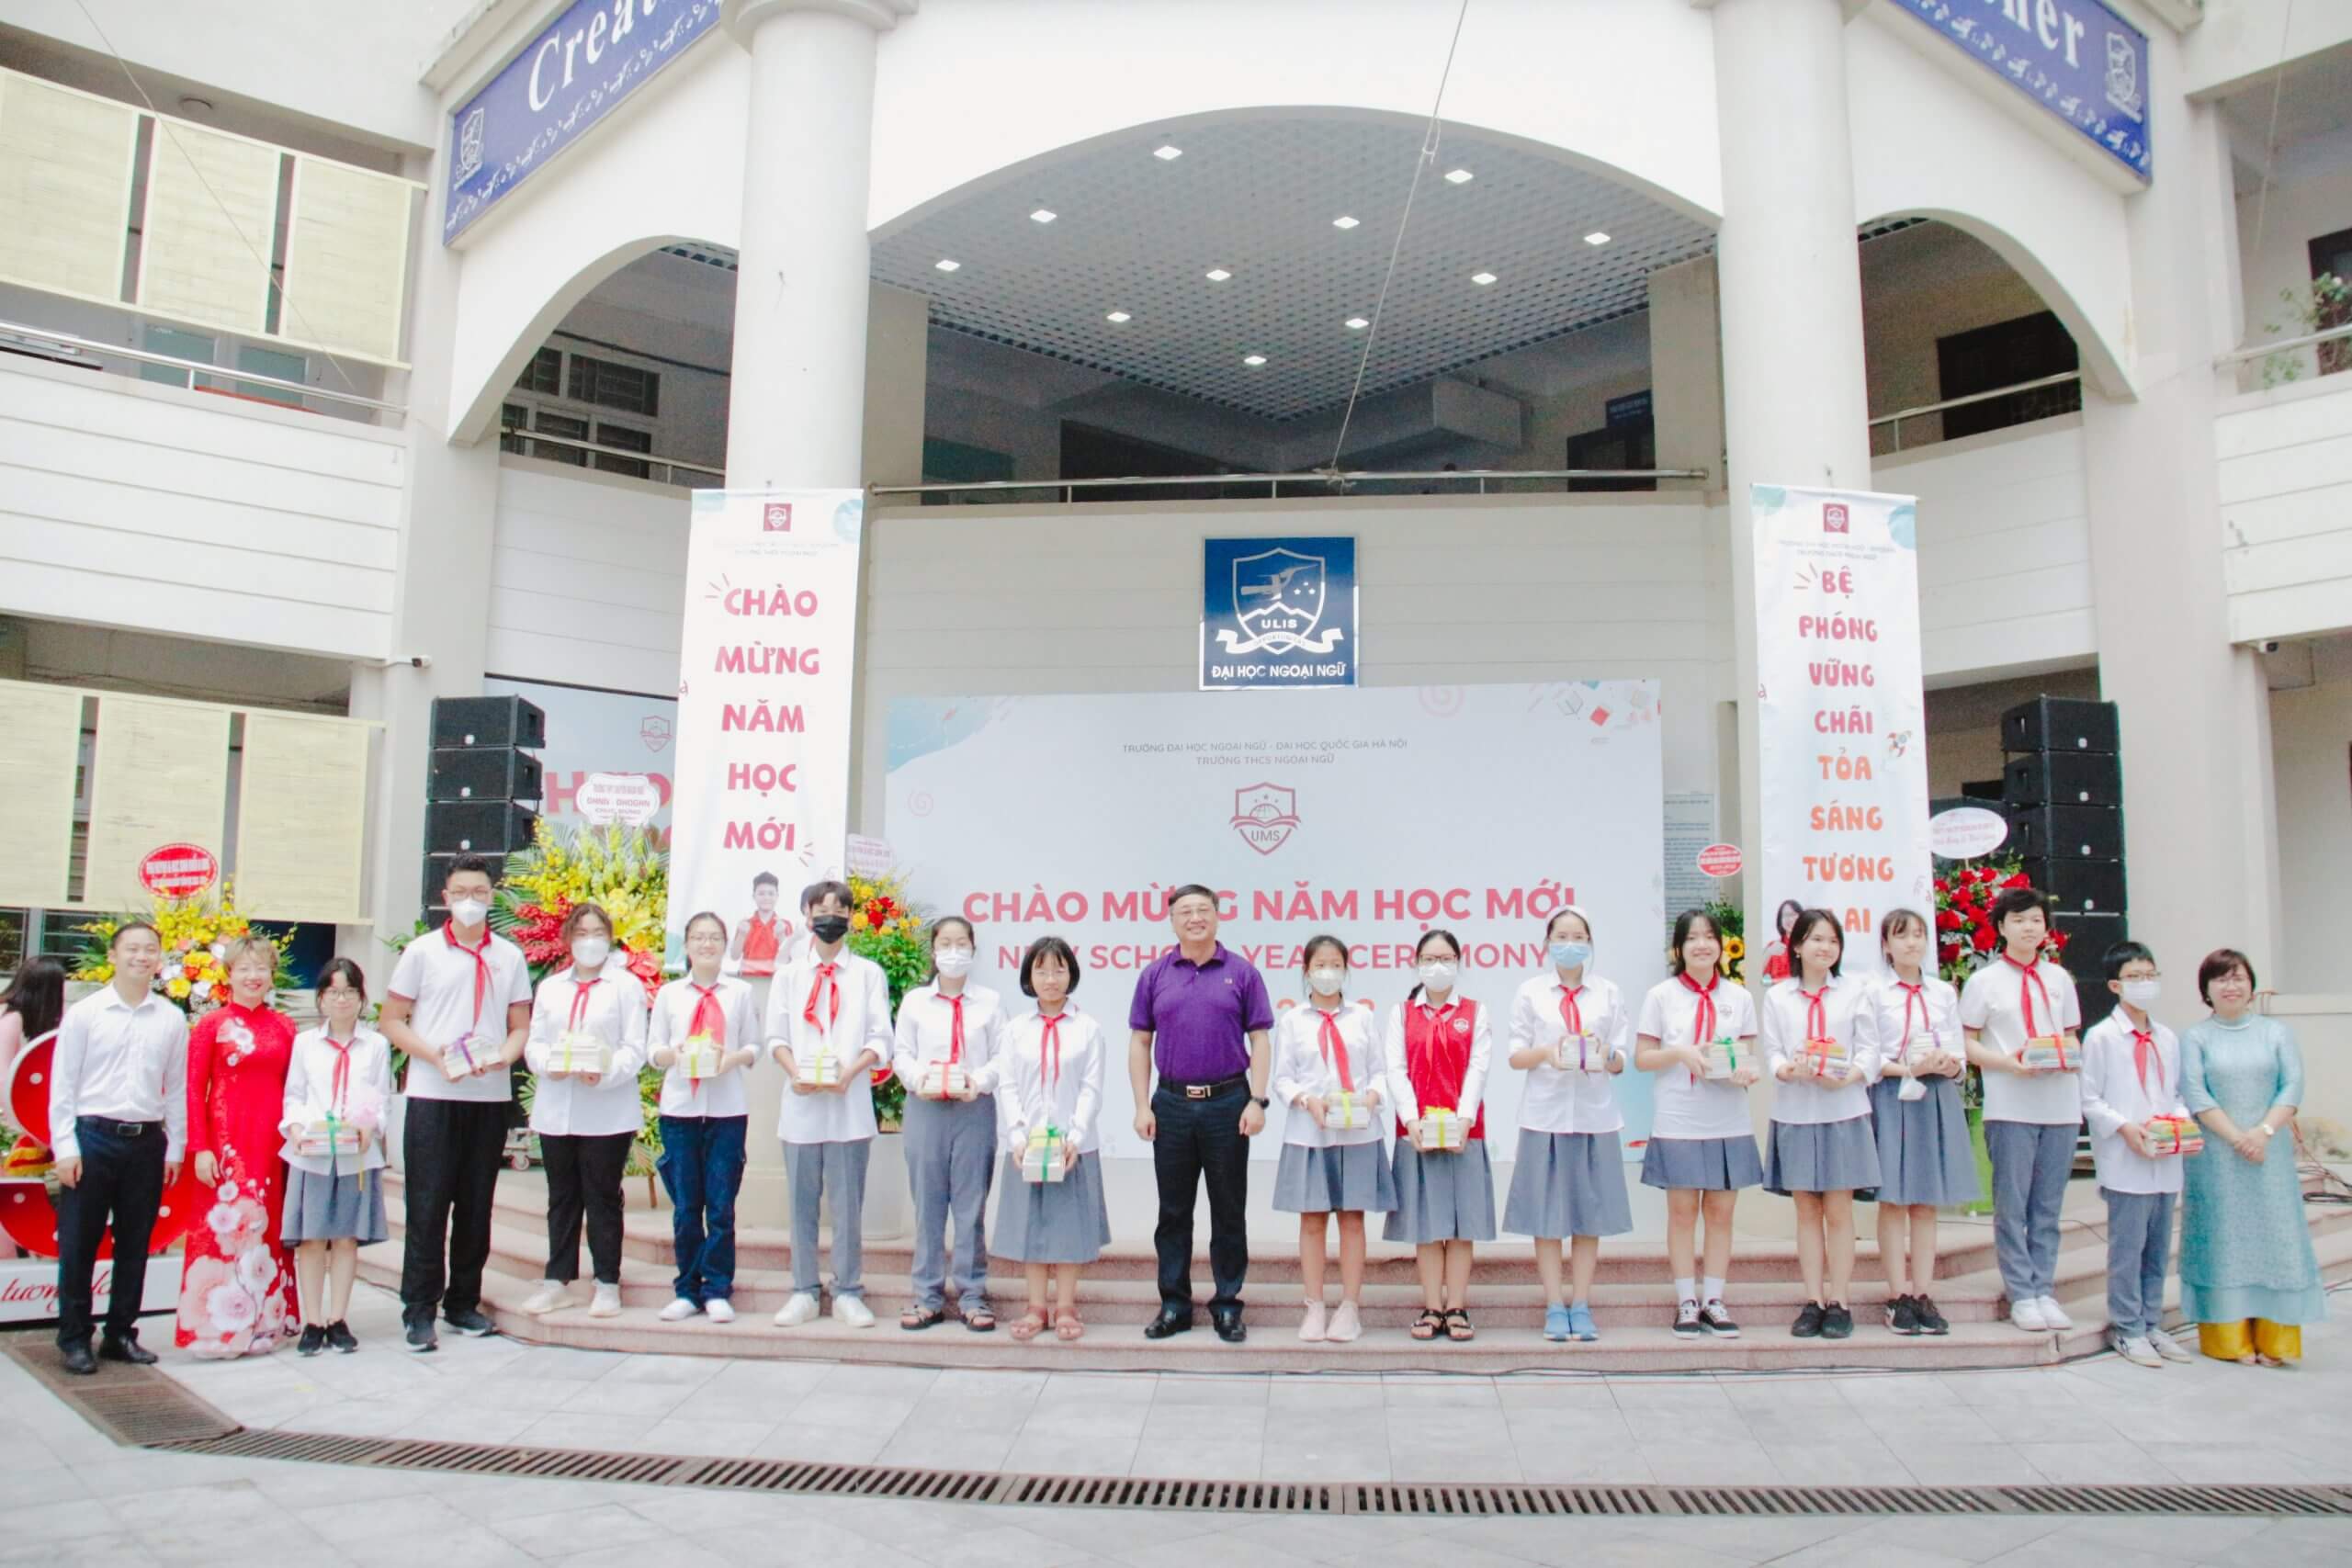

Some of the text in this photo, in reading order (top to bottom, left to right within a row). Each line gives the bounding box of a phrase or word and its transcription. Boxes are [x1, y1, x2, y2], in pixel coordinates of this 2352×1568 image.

[528, 0, 656, 111] Crea
[1822, 565, 1854, 599] BỆ
[724, 583, 818, 617] CHÀO
[1261, 619, 1297, 629] ULIS
[1799, 611, 1879, 642] PHÓNG
[714, 640, 820, 675] MỪNG
[1211, 661, 1347, 680] ĐẠI HỌC NGOẠI NGỮ
[1808, 658, 1875, 687] VỮNG
[721, 698, 805, 733] NĂM
[1815, 705, 1873, 734] CHÃI
[1817, 746, 1872, 781] TỎA
[728, 763, 797, 798] HỌC
[1810, 799, 1883, 831] SÁNG
[723, 817, 796, 851] MỚI
[1250, 829, 1281, 841] UMS
[1802, 852, 1894, 883] TƯƠNG
[963, 878, 1576, 932] CHÀO MỪG NĂM HỌC MỚI
[1241, 944, 1305, 969] YEA
[1347, 943, 1548, 970] CERONY
